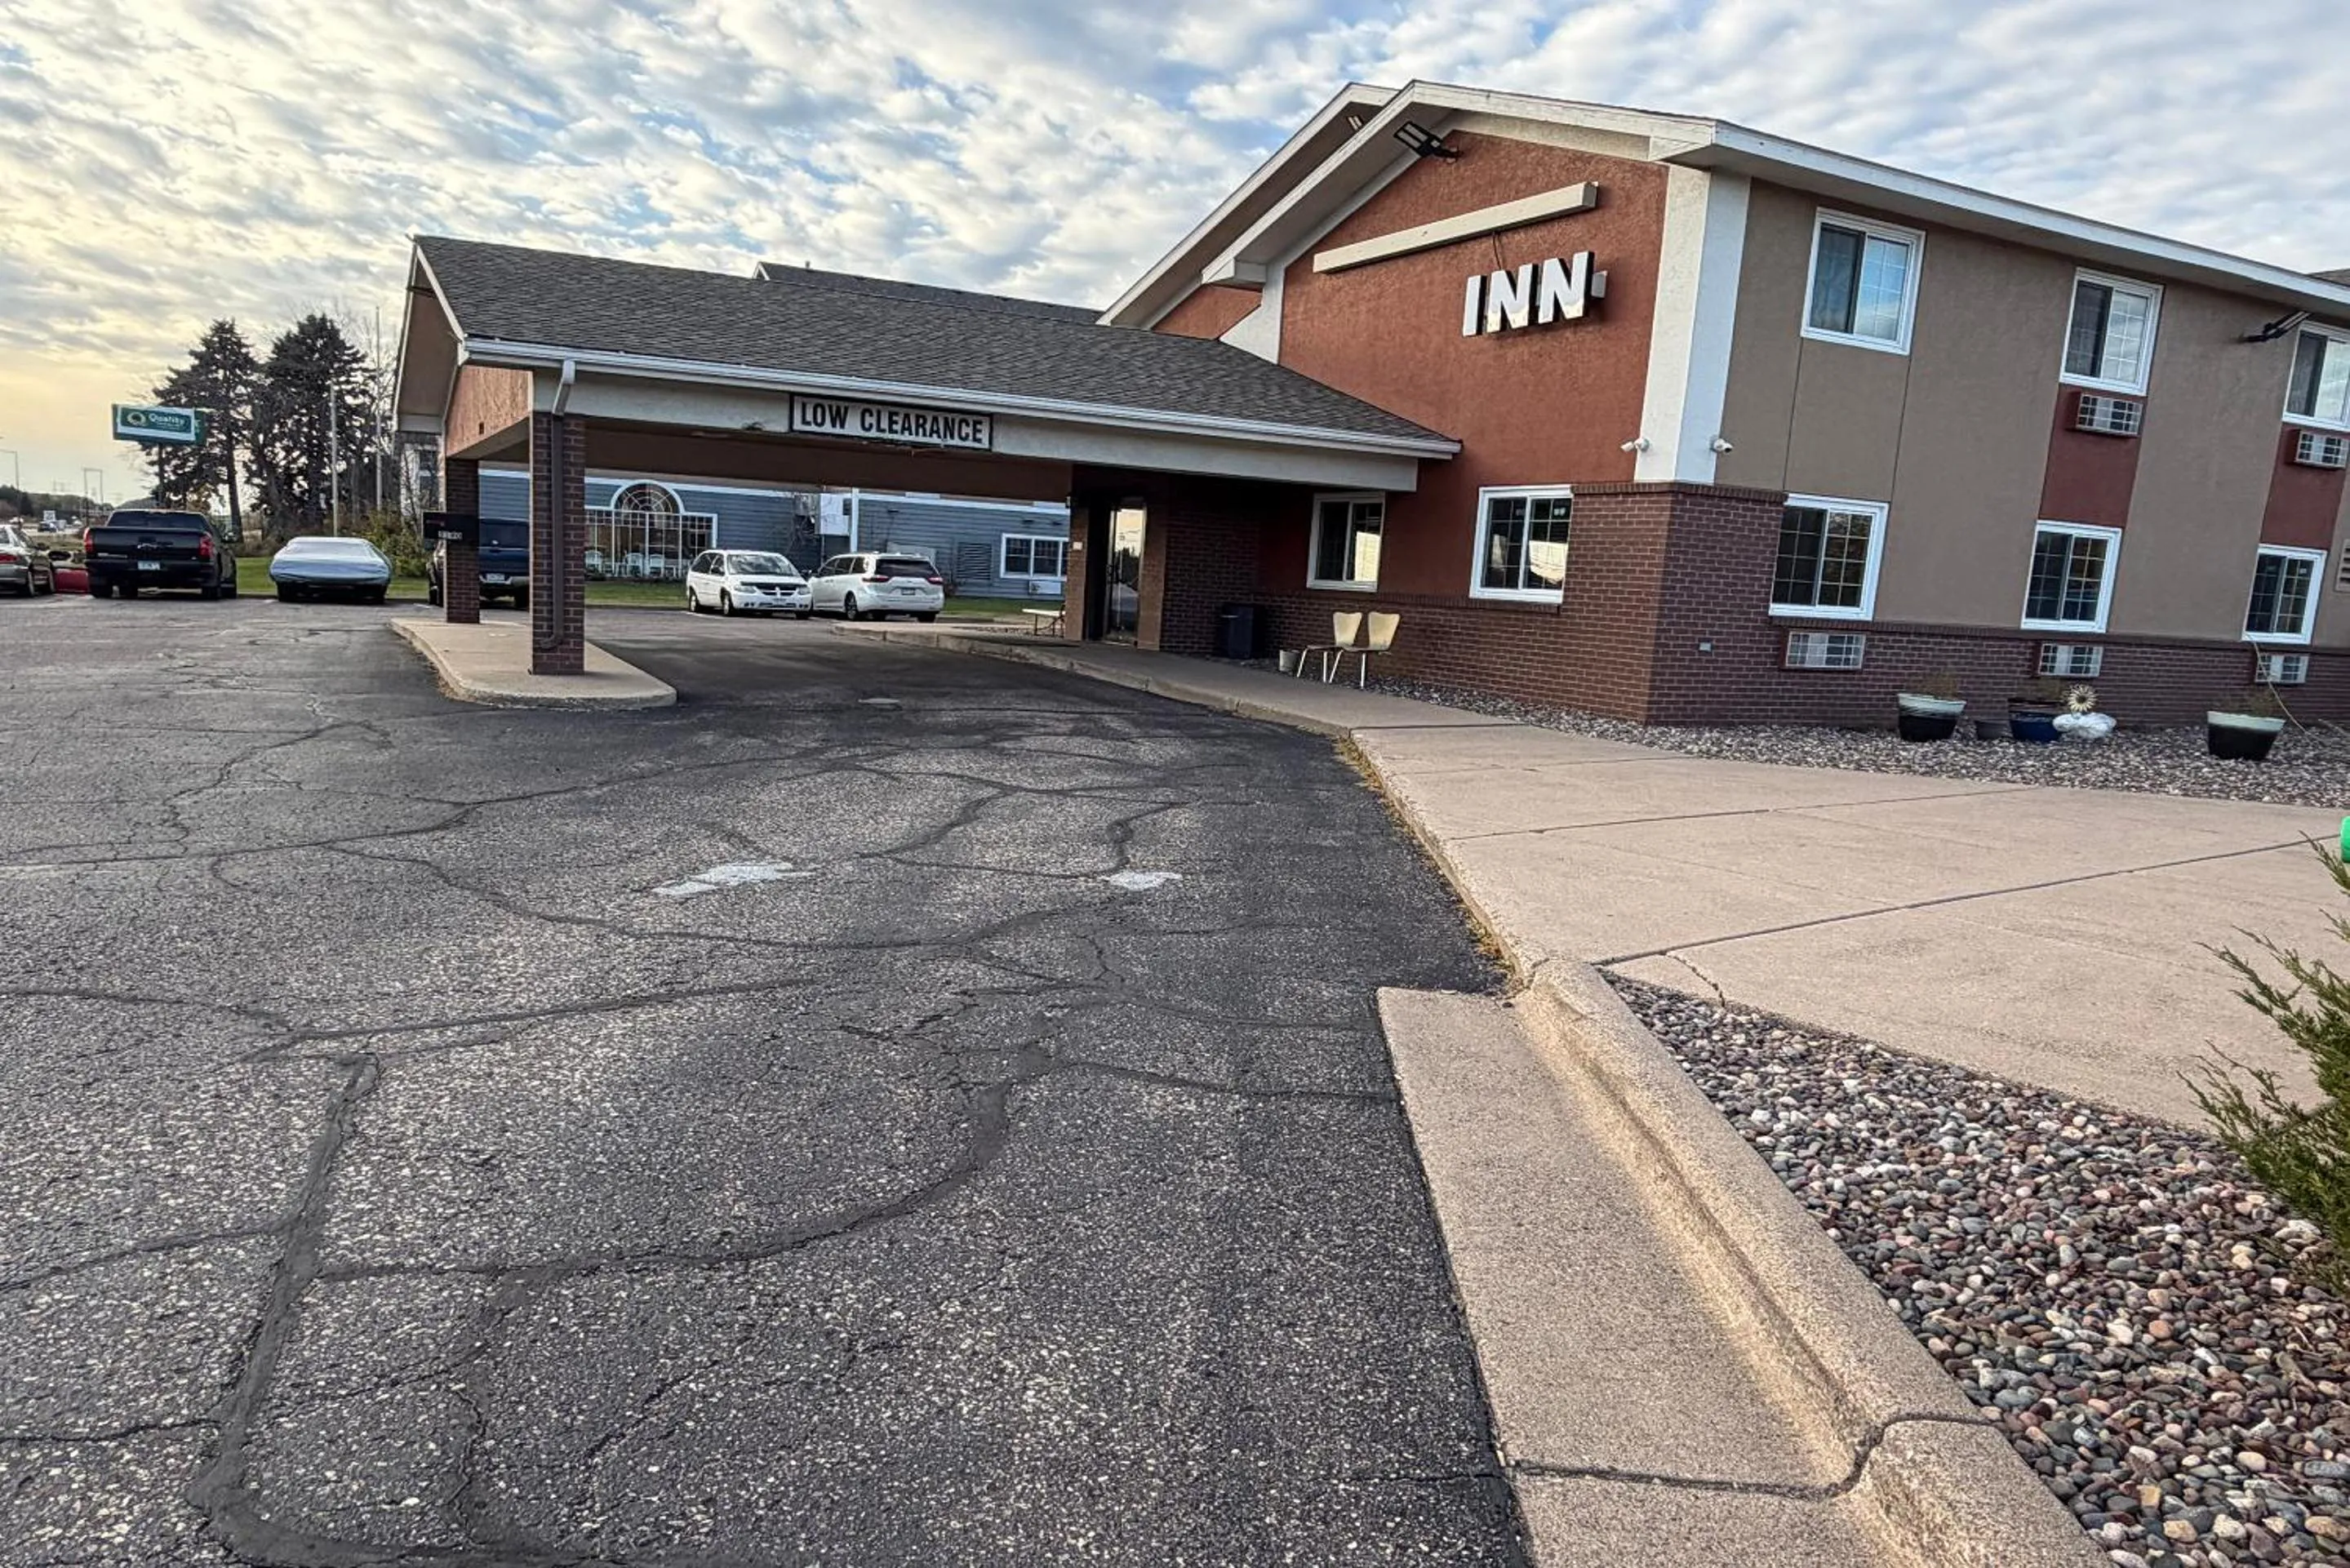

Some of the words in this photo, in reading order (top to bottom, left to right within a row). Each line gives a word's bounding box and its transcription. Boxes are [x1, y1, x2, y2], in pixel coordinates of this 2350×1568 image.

[1463, 251, 1594, 337] INN
[801, 402, 849, 429] LOW
[860, 407, 983, 443] CLEARANCE
